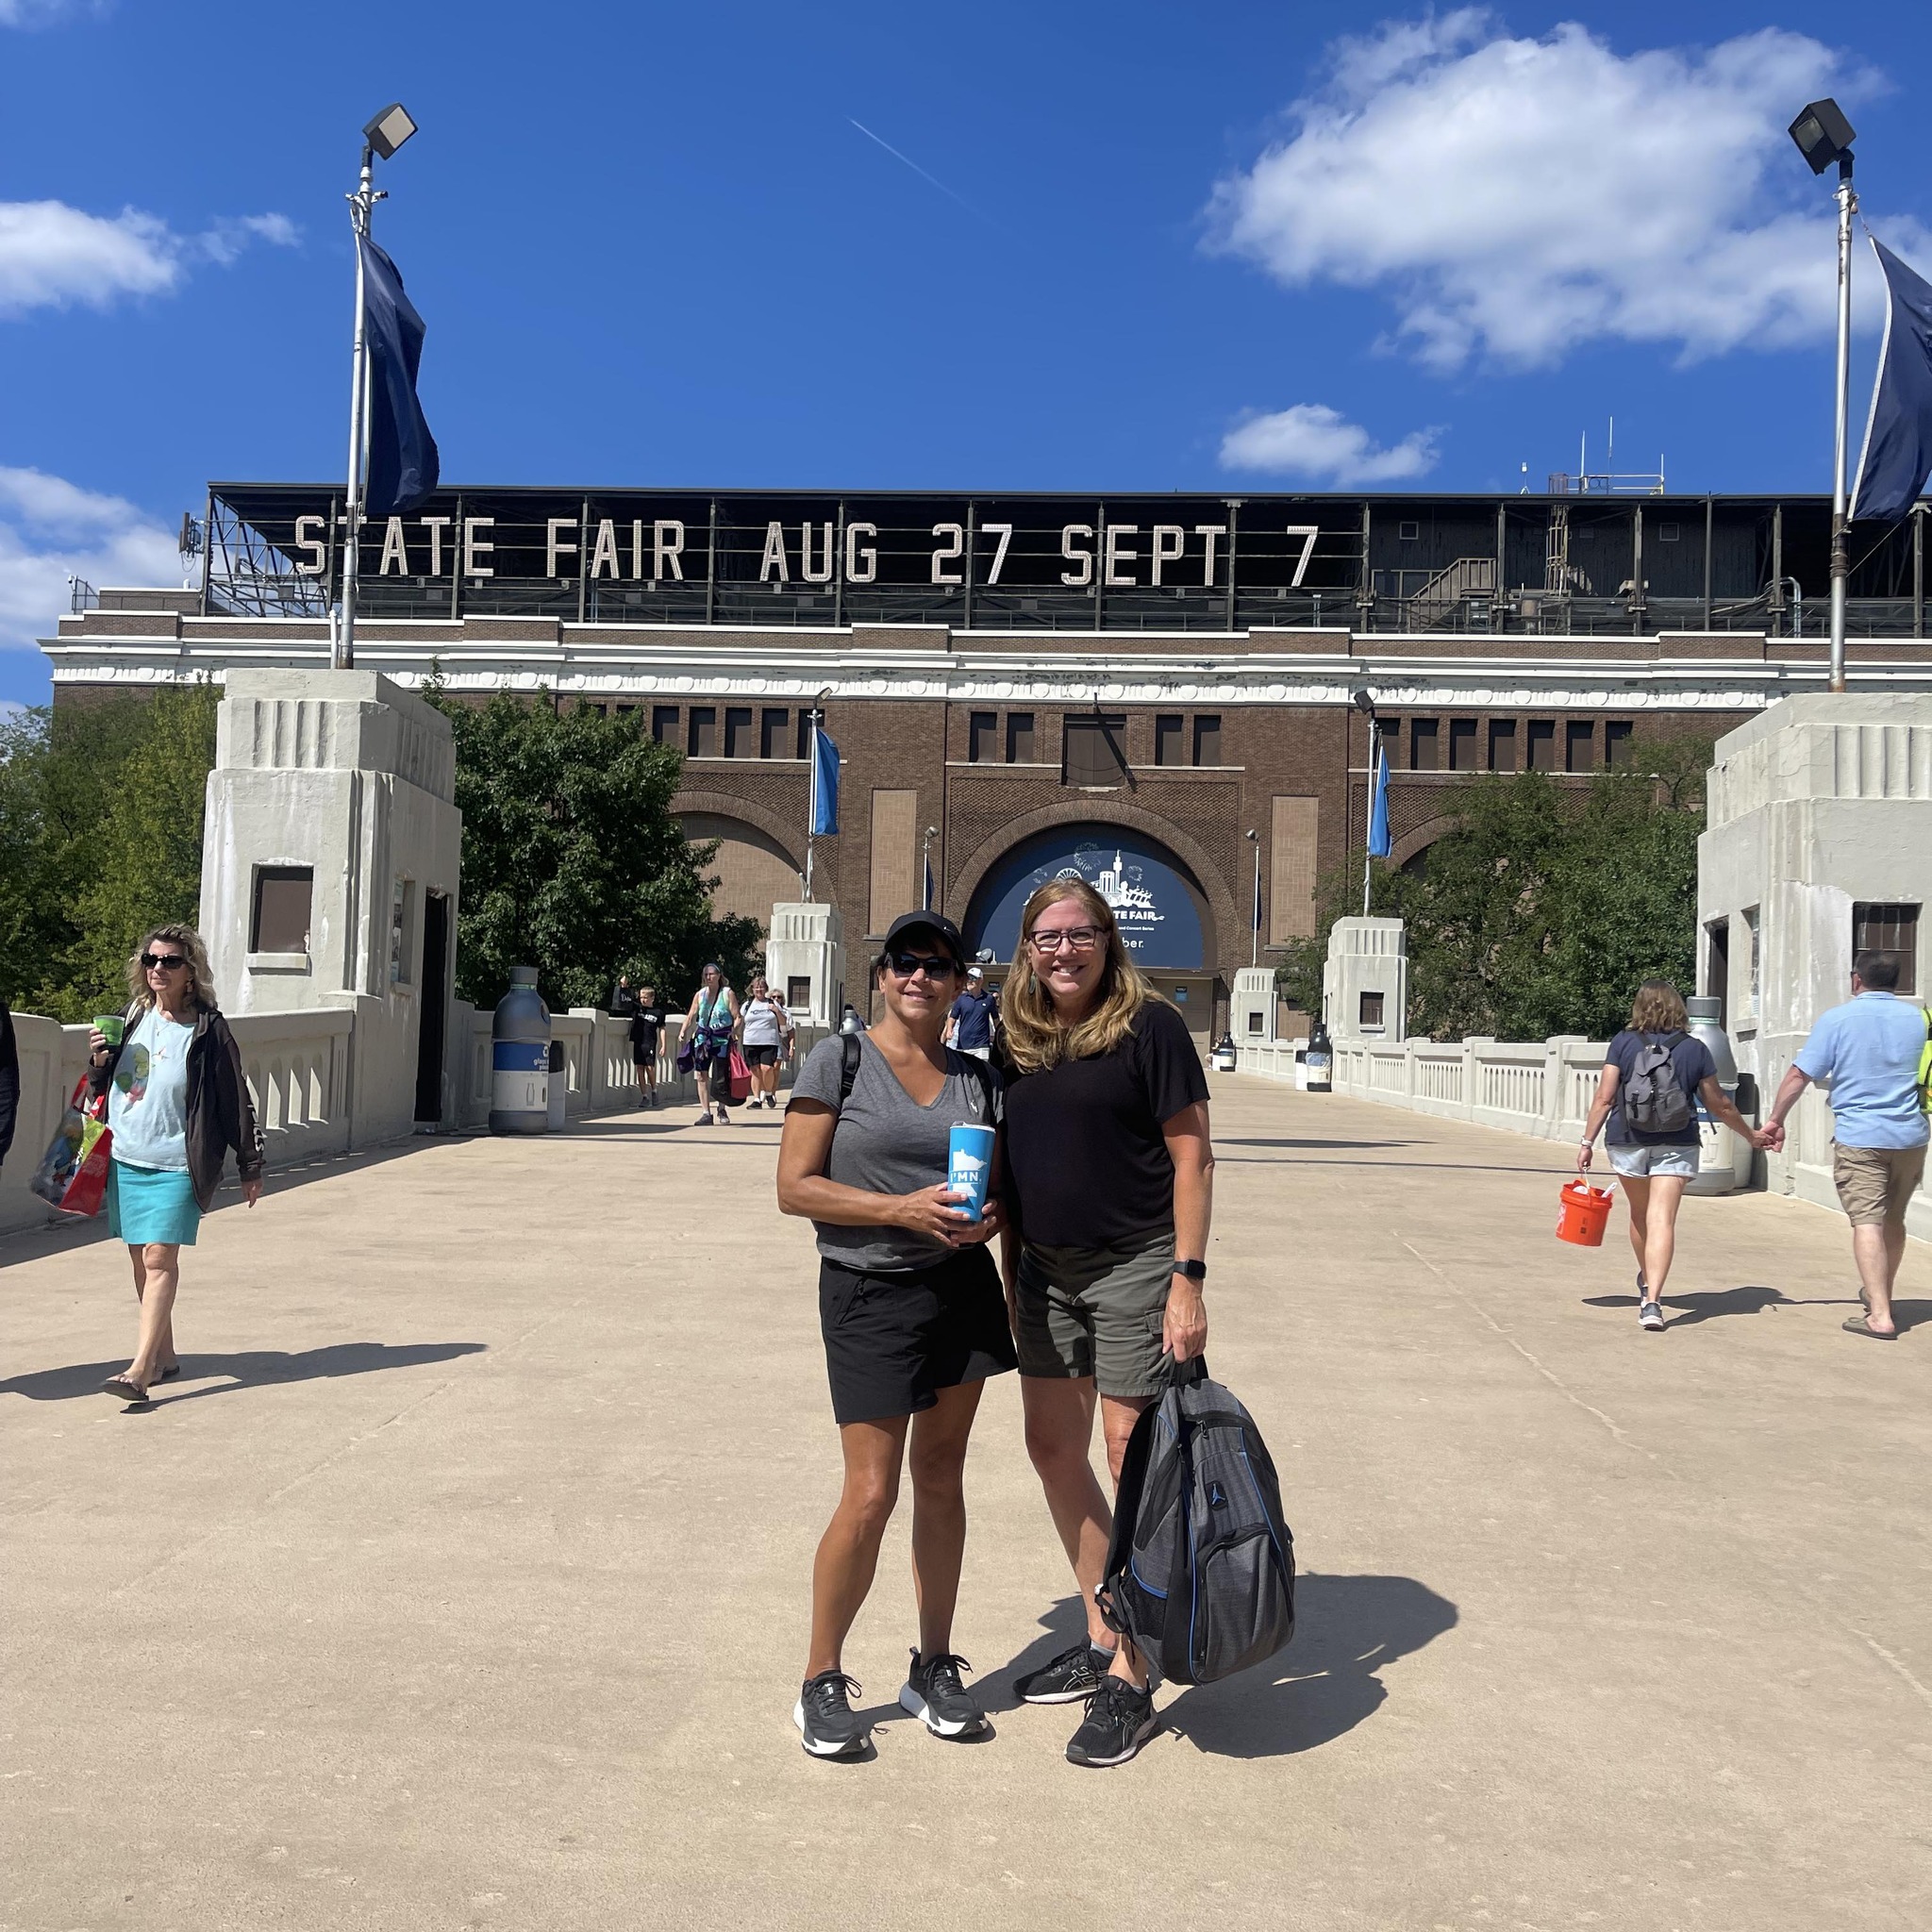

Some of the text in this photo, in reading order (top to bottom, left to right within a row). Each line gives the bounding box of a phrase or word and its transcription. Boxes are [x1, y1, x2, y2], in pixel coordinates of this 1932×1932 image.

[546, 518, 685, 581] FAIR
[759, 521, 877, 584] AUG
[931, 523, 1013, 585] 27
[1061, 524, 1227, 587] SEPT
[1286, 525, 1319, 588] 7
[1112, 910, 1164, 922] TE FAIR
